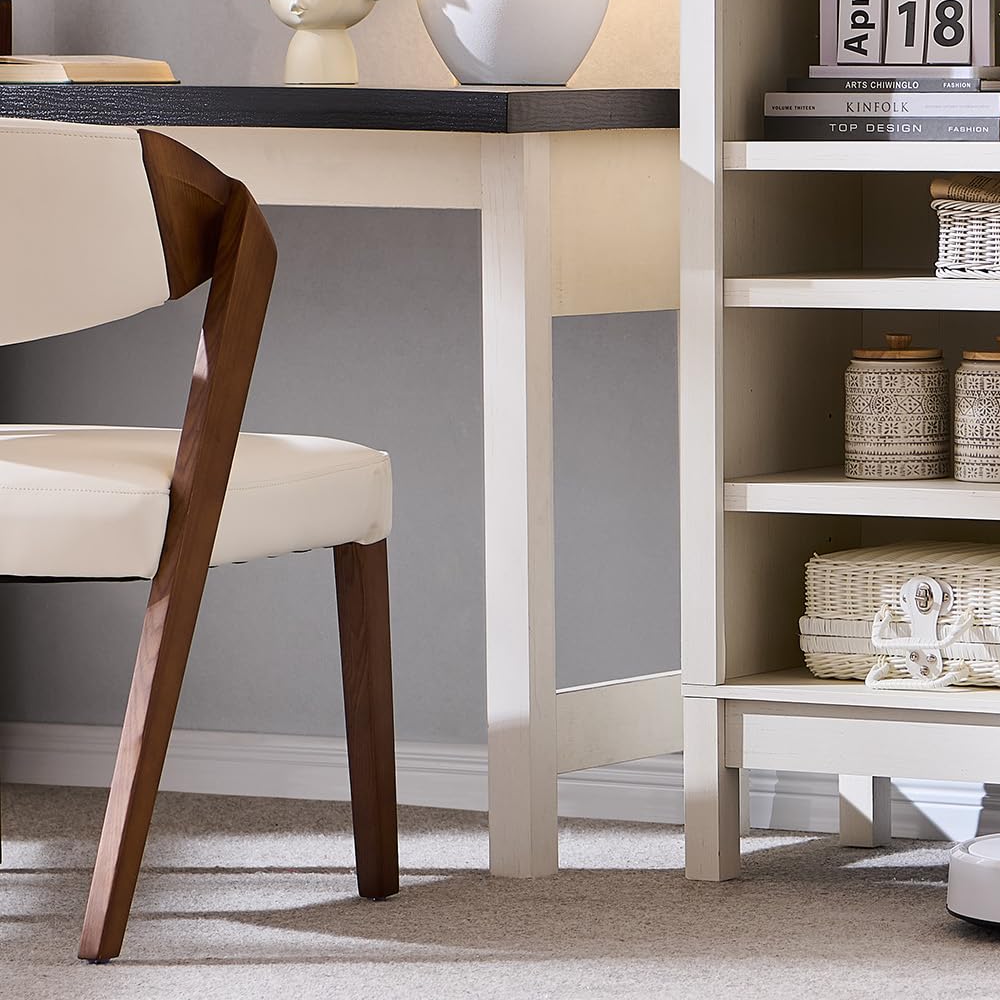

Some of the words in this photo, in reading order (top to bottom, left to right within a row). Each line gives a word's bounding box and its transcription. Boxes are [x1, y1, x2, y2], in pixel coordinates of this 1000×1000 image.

[845, 81, 868, 89] ARTS
[870, 81, 919, 90] CHIWINGLO
[846, 102, 910, 113] KINFOLK
[829, 123, 858, 133] TOP
[866, 123, 923, 133] DESIGN
